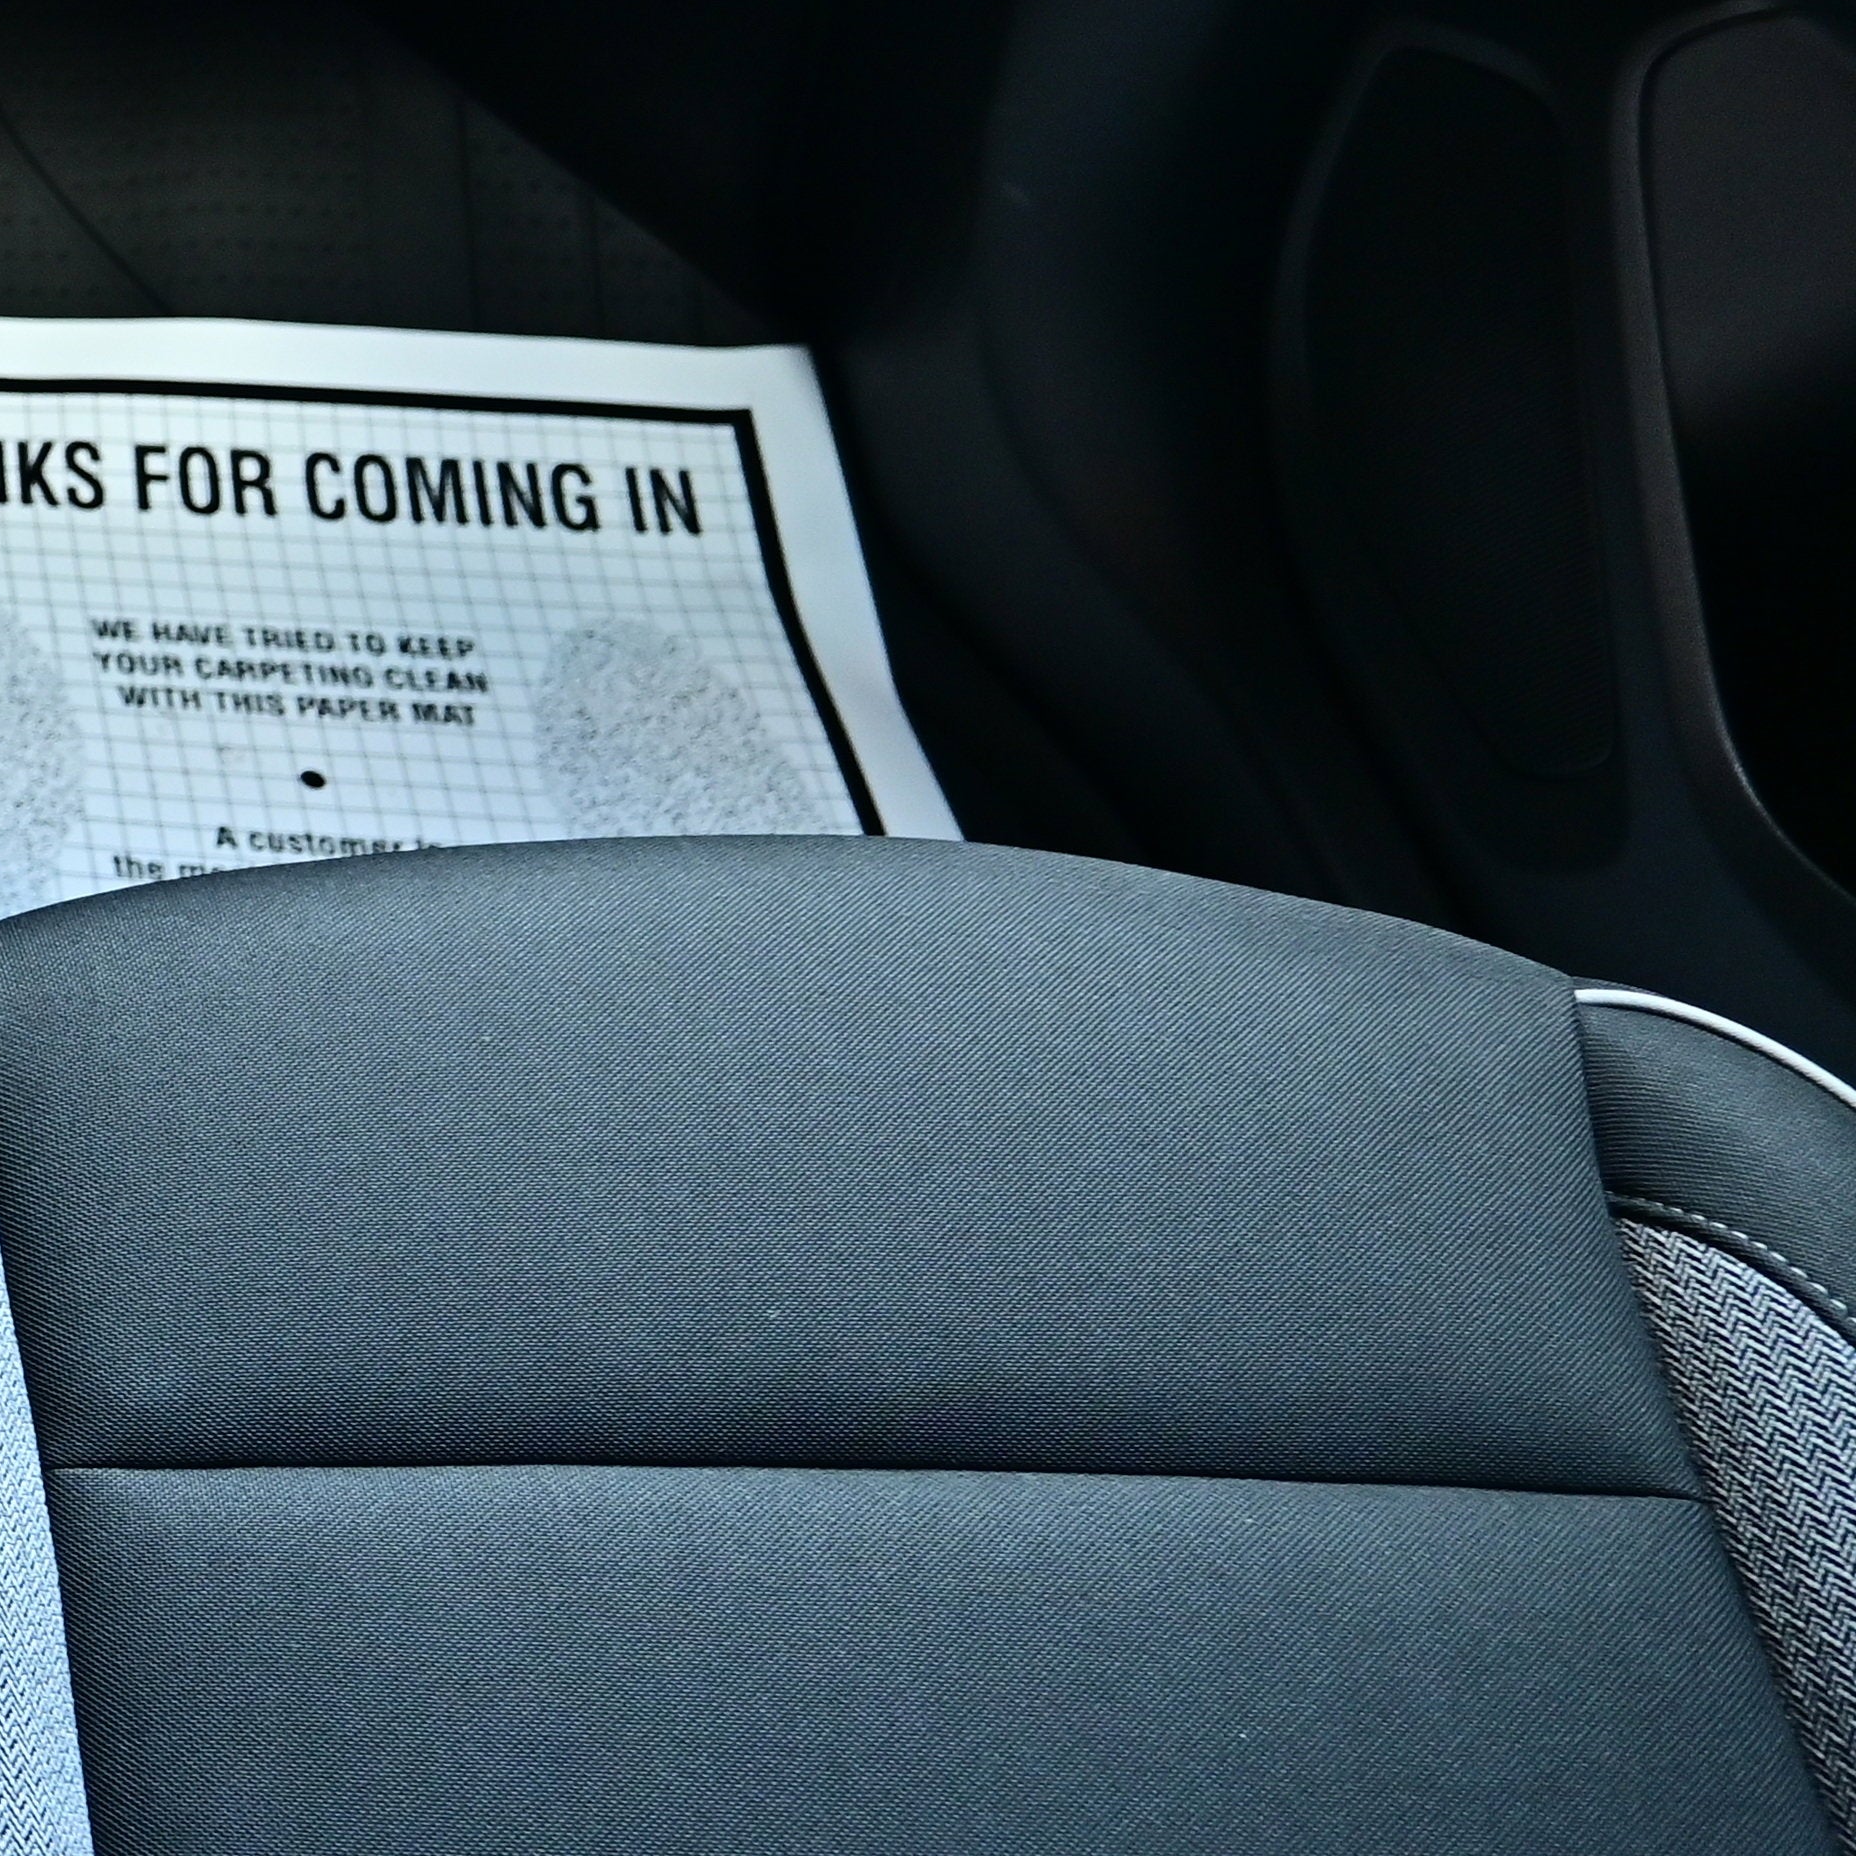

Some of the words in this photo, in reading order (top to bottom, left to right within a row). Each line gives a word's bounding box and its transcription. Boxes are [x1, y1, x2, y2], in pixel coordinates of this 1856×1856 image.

[135, 444, 278, 518] FOR
[305, 450, 600, 536] COMING
[627, 468, 703, 538] IN
[91, 619, 139, 641] WE
[152, 621, 232, 645] HAVE
[243, 626, 336, 652] TRIED
[346, 631, 387, 655] TO
[398, 635, 475, 660] KEEP
[94, 651, 184, 675] YOUR
[194, 656, 374, 687] CARPETING
[384, 667, 489, 693] CLEAN
[117, 684, 201, 709] WITH
[216, 690, 285, 716] THIS
[297, 695, 400, 722] PAPER
[411, 702, 476, 727] MAT
[217, 825, 239, 848] A
[113, 853, 163, 880] the
